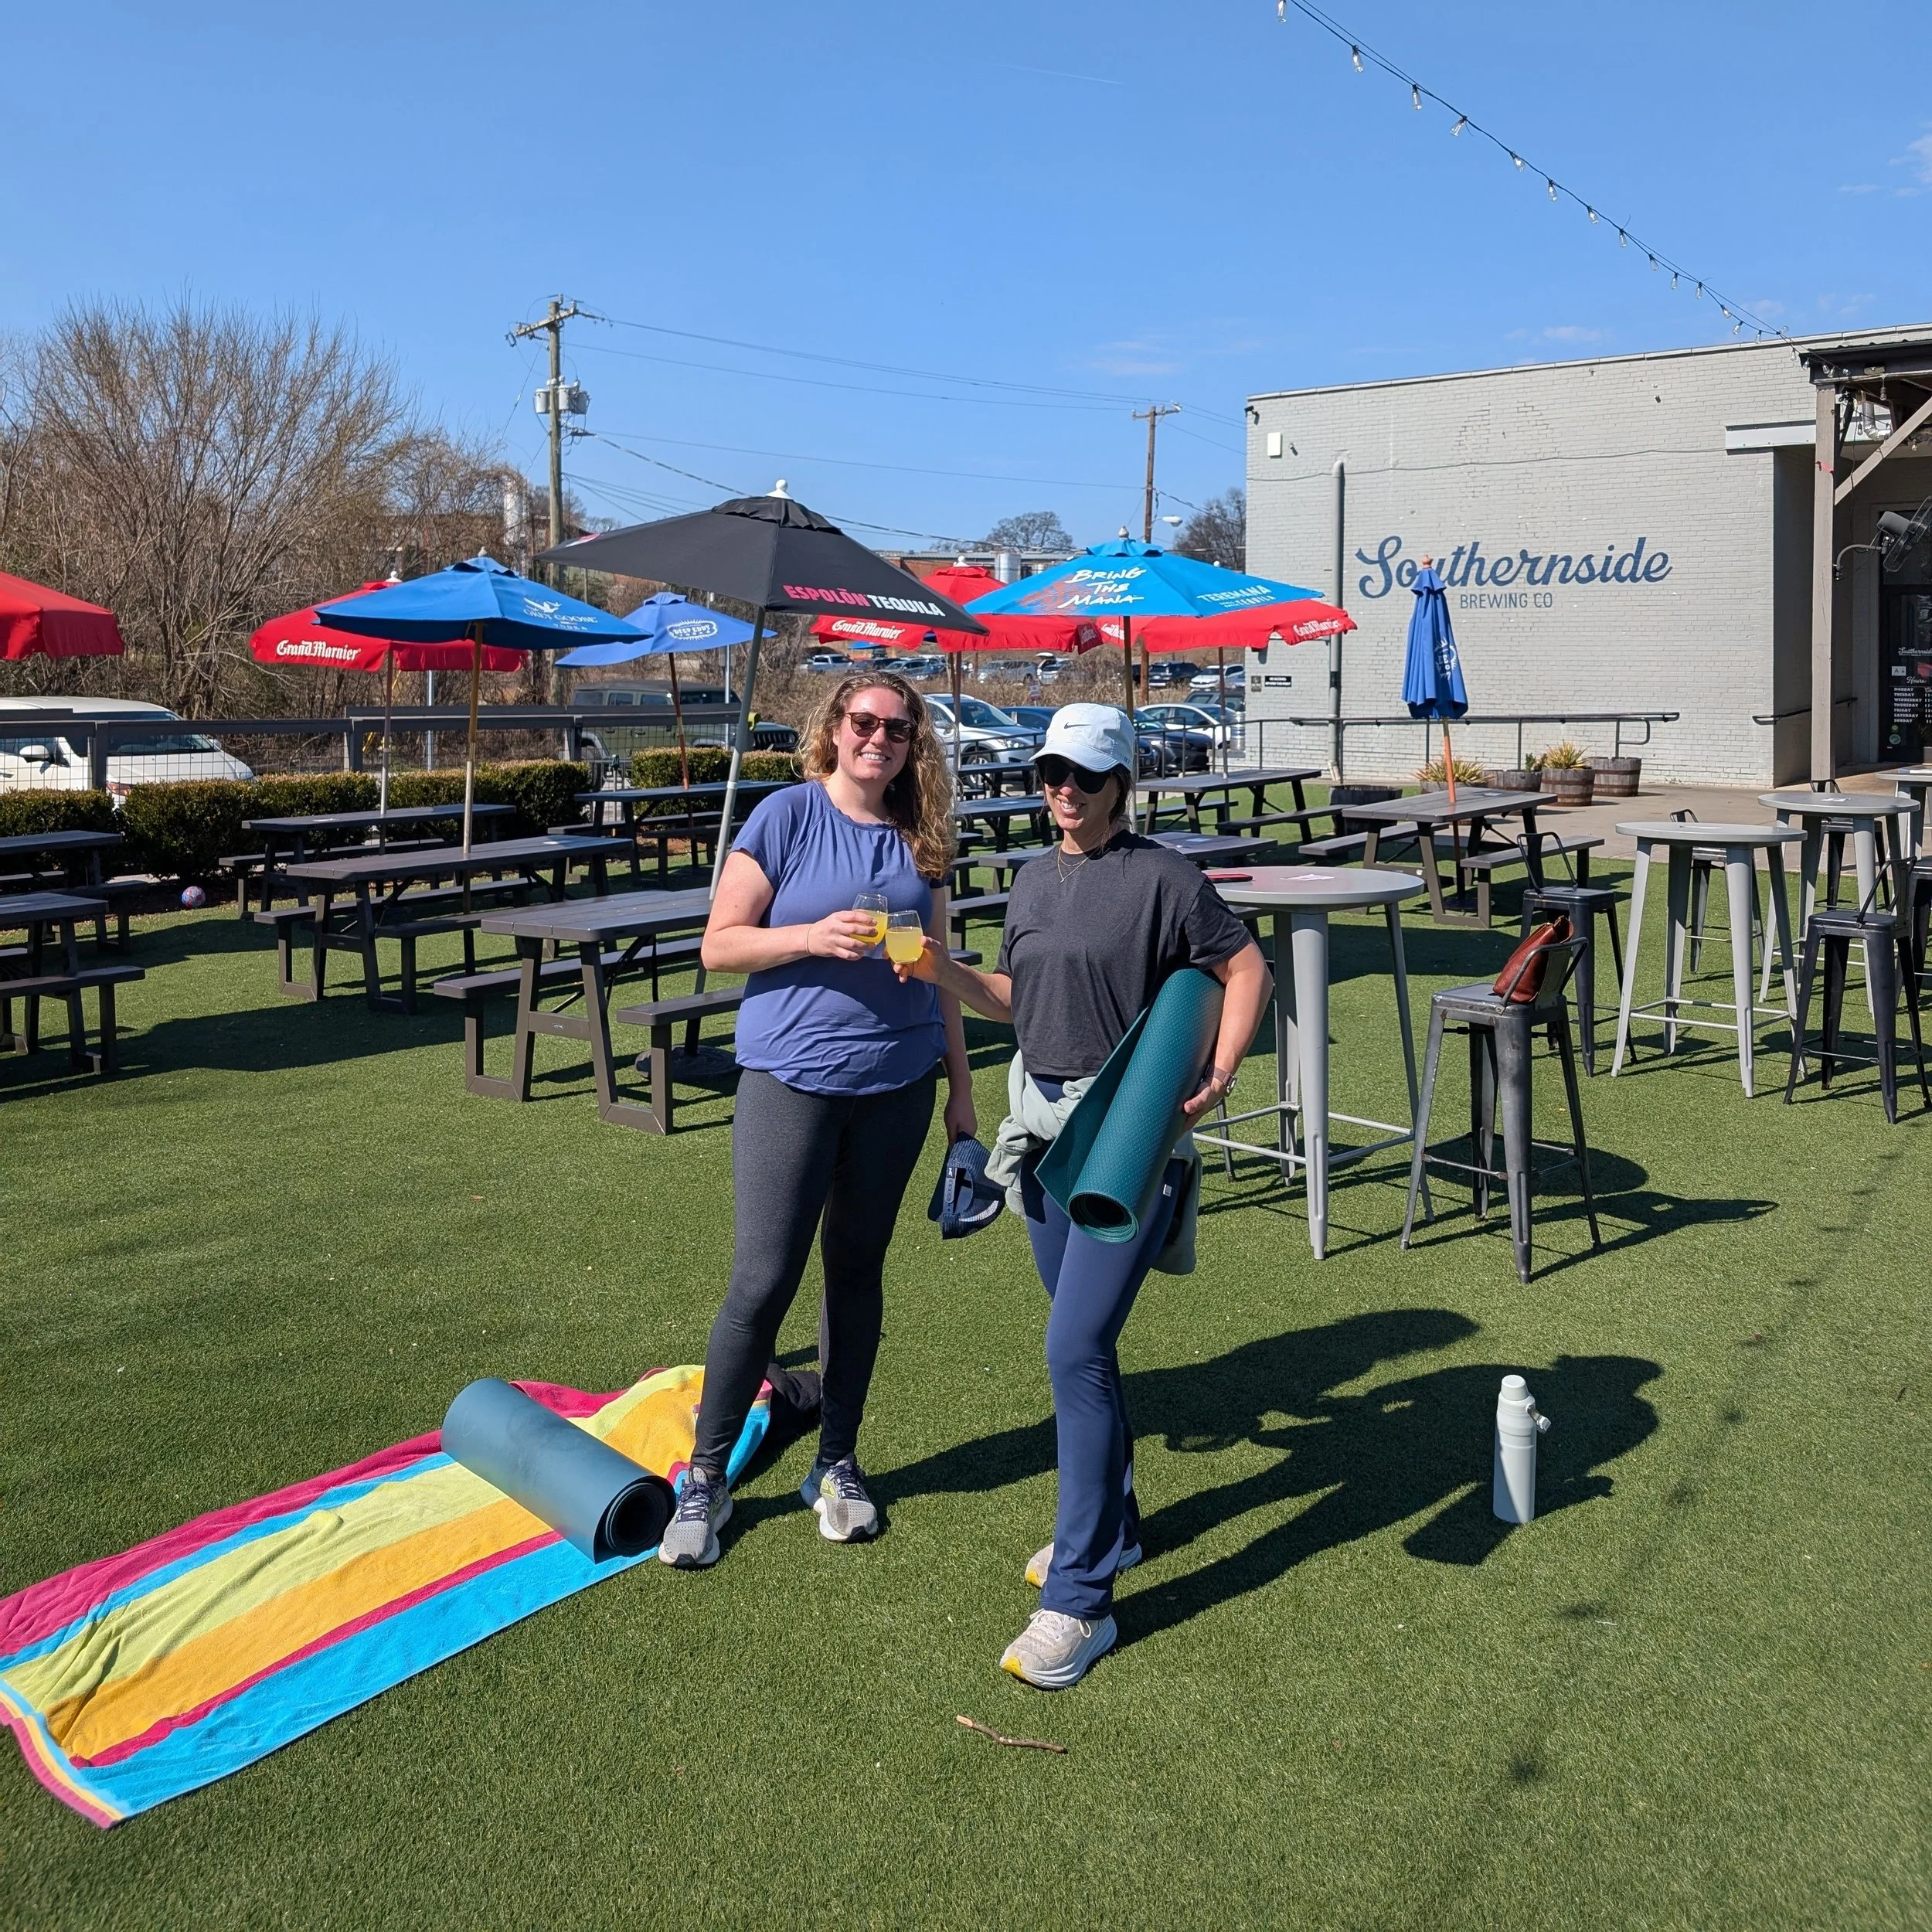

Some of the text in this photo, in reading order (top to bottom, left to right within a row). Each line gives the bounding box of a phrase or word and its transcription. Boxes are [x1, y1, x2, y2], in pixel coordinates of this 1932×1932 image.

[1087, 580, 1130, 594] THE
[1196, 584, 1272, 603] TEREMANA
[866, 594, 946, 617] TEQUILA
[1057, 594, 1145, 609] MANA
[1460, 592, 1553, 609] BREWING CO
[523, 608, 598, 624] GREY GOOSE
[832, 619, 903, 640] Grand Marnier
[276, 639, 359, 662] Grand Marnier
